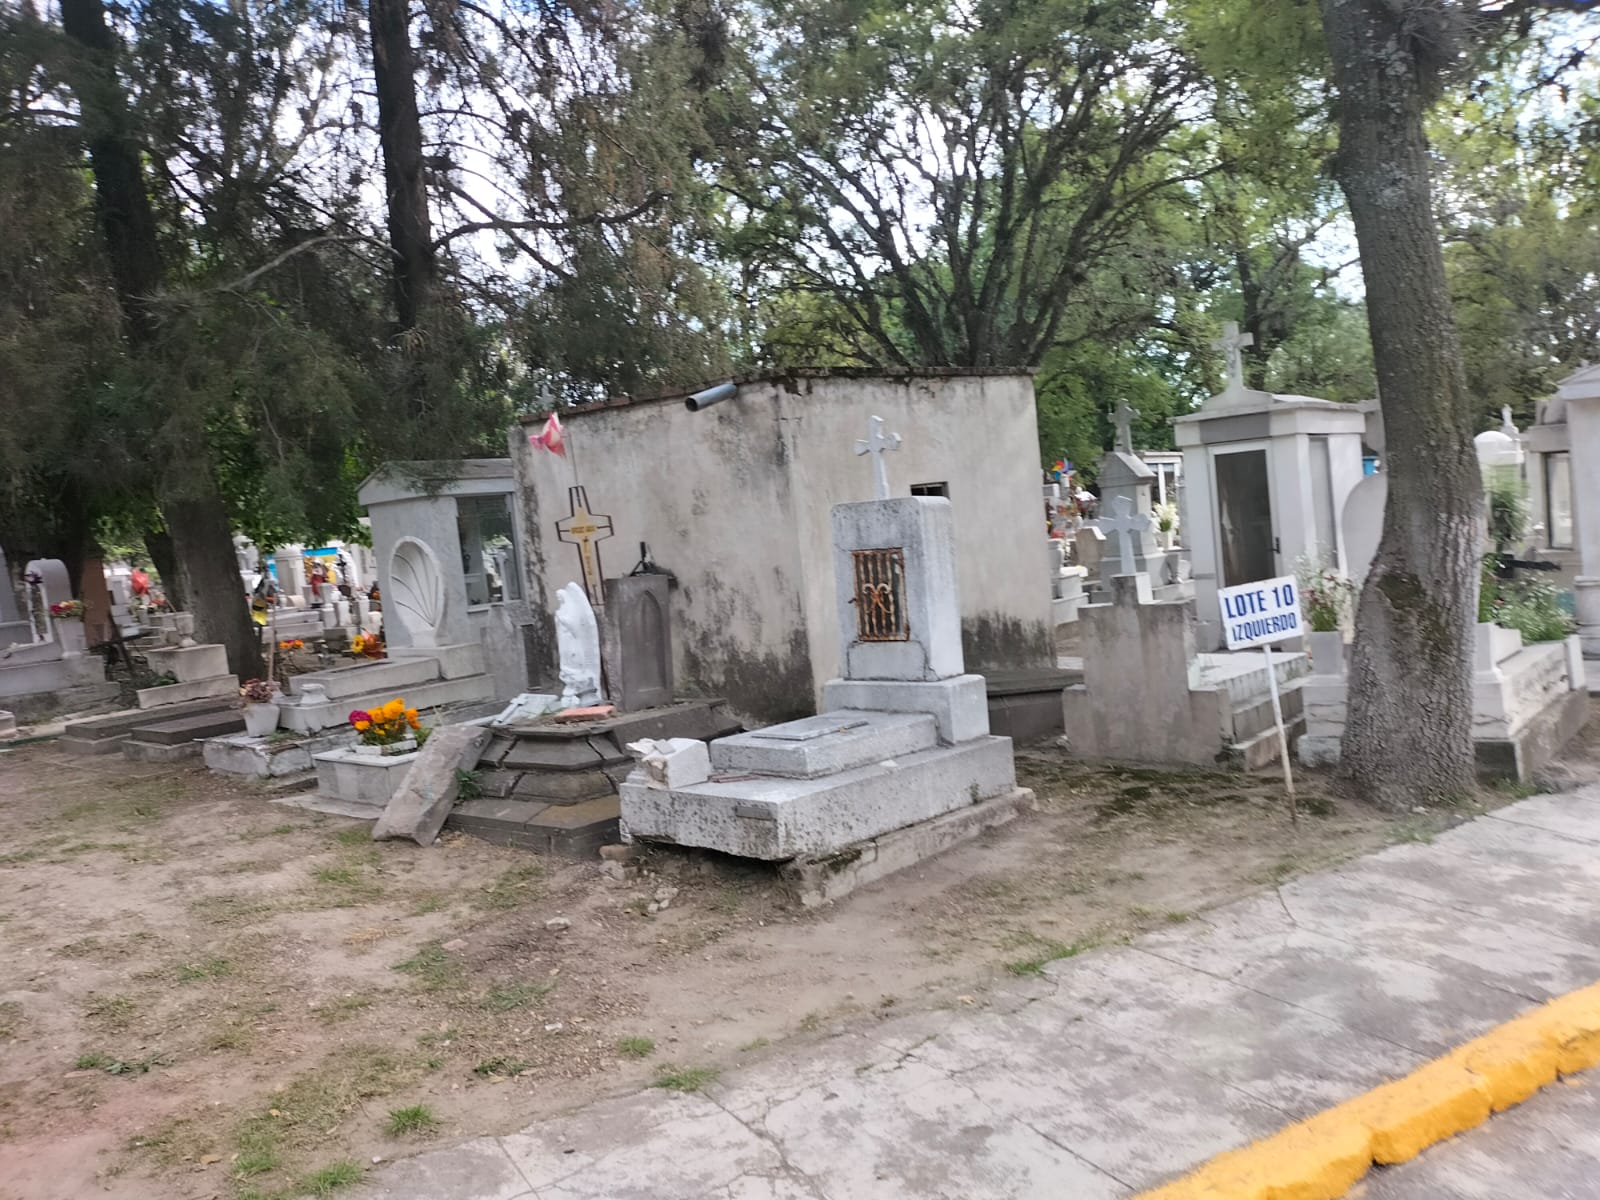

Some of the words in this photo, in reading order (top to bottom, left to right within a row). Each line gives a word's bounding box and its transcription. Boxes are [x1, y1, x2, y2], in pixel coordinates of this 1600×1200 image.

[1224, 590, 1267, 618] LOTE
[1272, 584, 1294, 608] 10
[1232, 612, 1297, 641] IZQUIERDO
